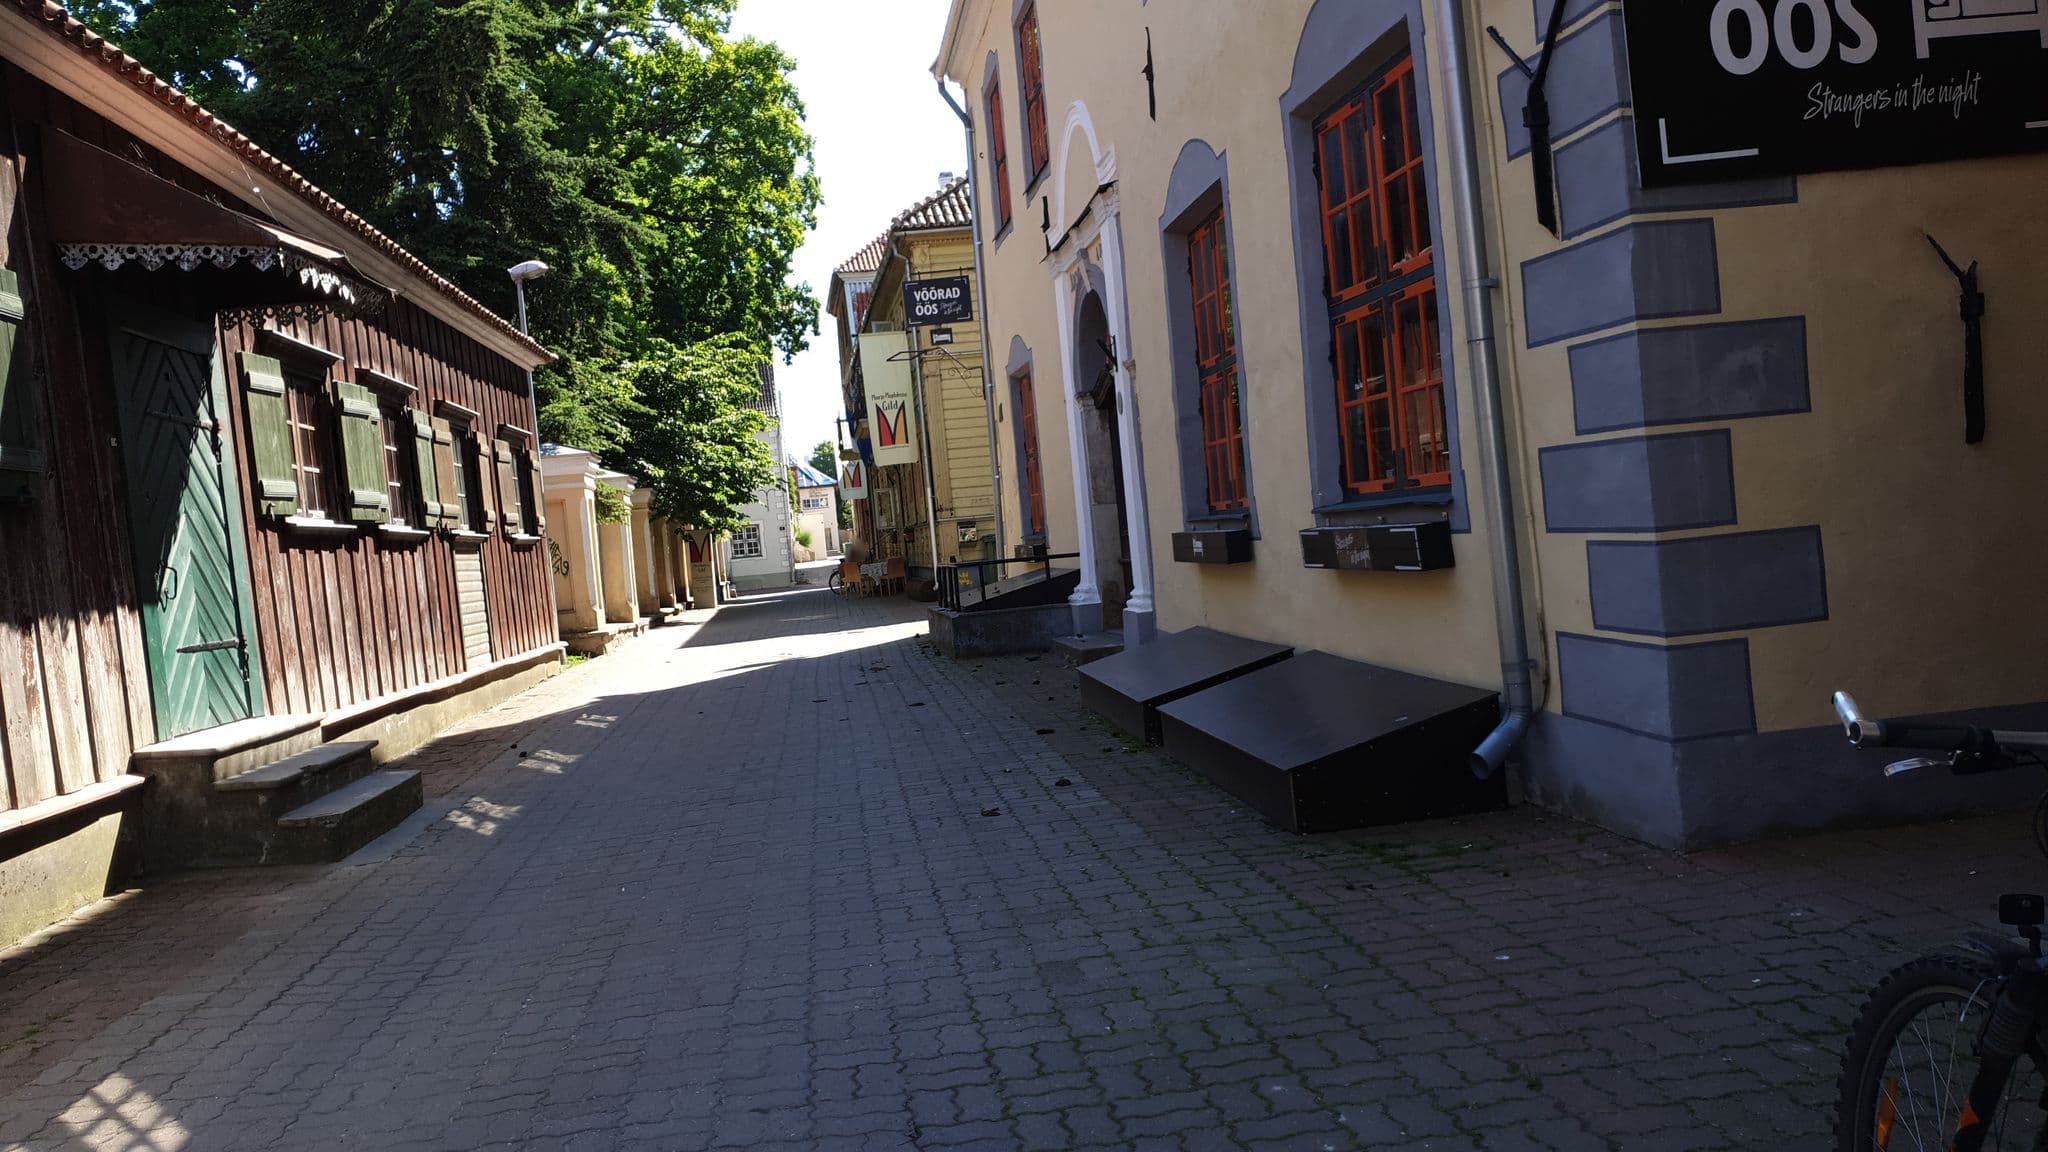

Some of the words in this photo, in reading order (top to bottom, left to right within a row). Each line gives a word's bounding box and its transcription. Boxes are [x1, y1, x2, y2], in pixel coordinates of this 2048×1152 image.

[1803, 82, 1892, 129] Strangers
[1894, 83, 1908, 108] in
[1911, 73, 1936, 111] the
[1938, 69, 1982, 120] night
[882, 400, 899, 411] Gild
